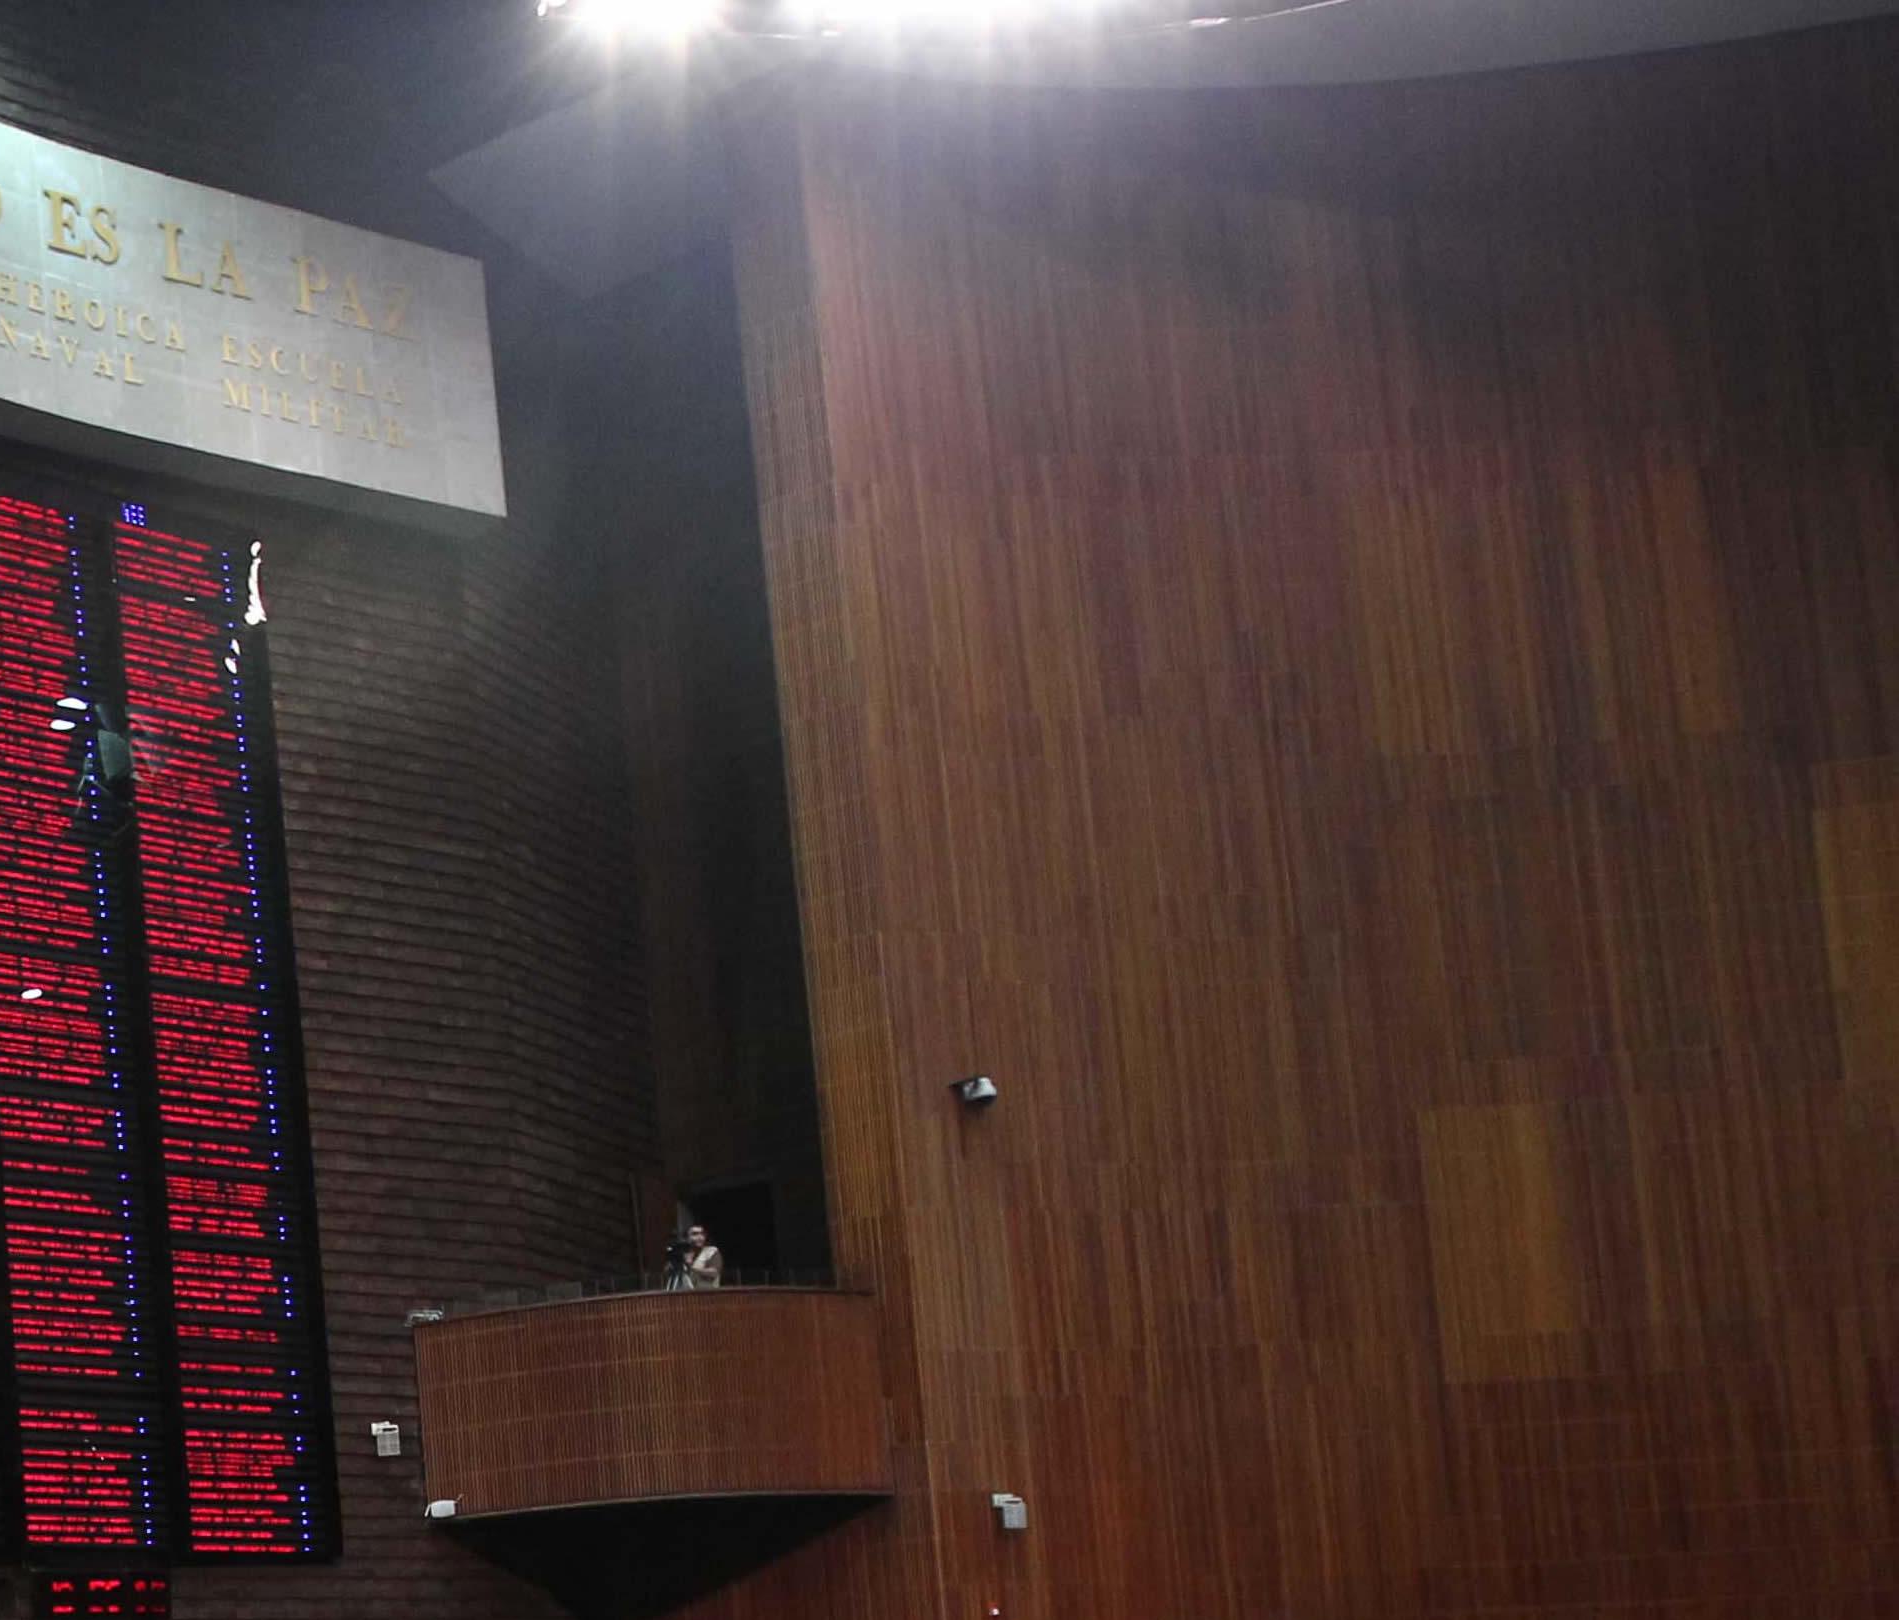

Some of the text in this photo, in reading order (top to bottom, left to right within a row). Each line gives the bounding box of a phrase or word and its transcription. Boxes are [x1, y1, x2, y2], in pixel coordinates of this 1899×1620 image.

[42, 186, 121, 266] ES
[157, 219, 254, 301] LA
[291, 254, 421, 344] PAZ
[221, 333, 405, 408] ESCUELA
[221, 377, 415, 450] MILITAR
